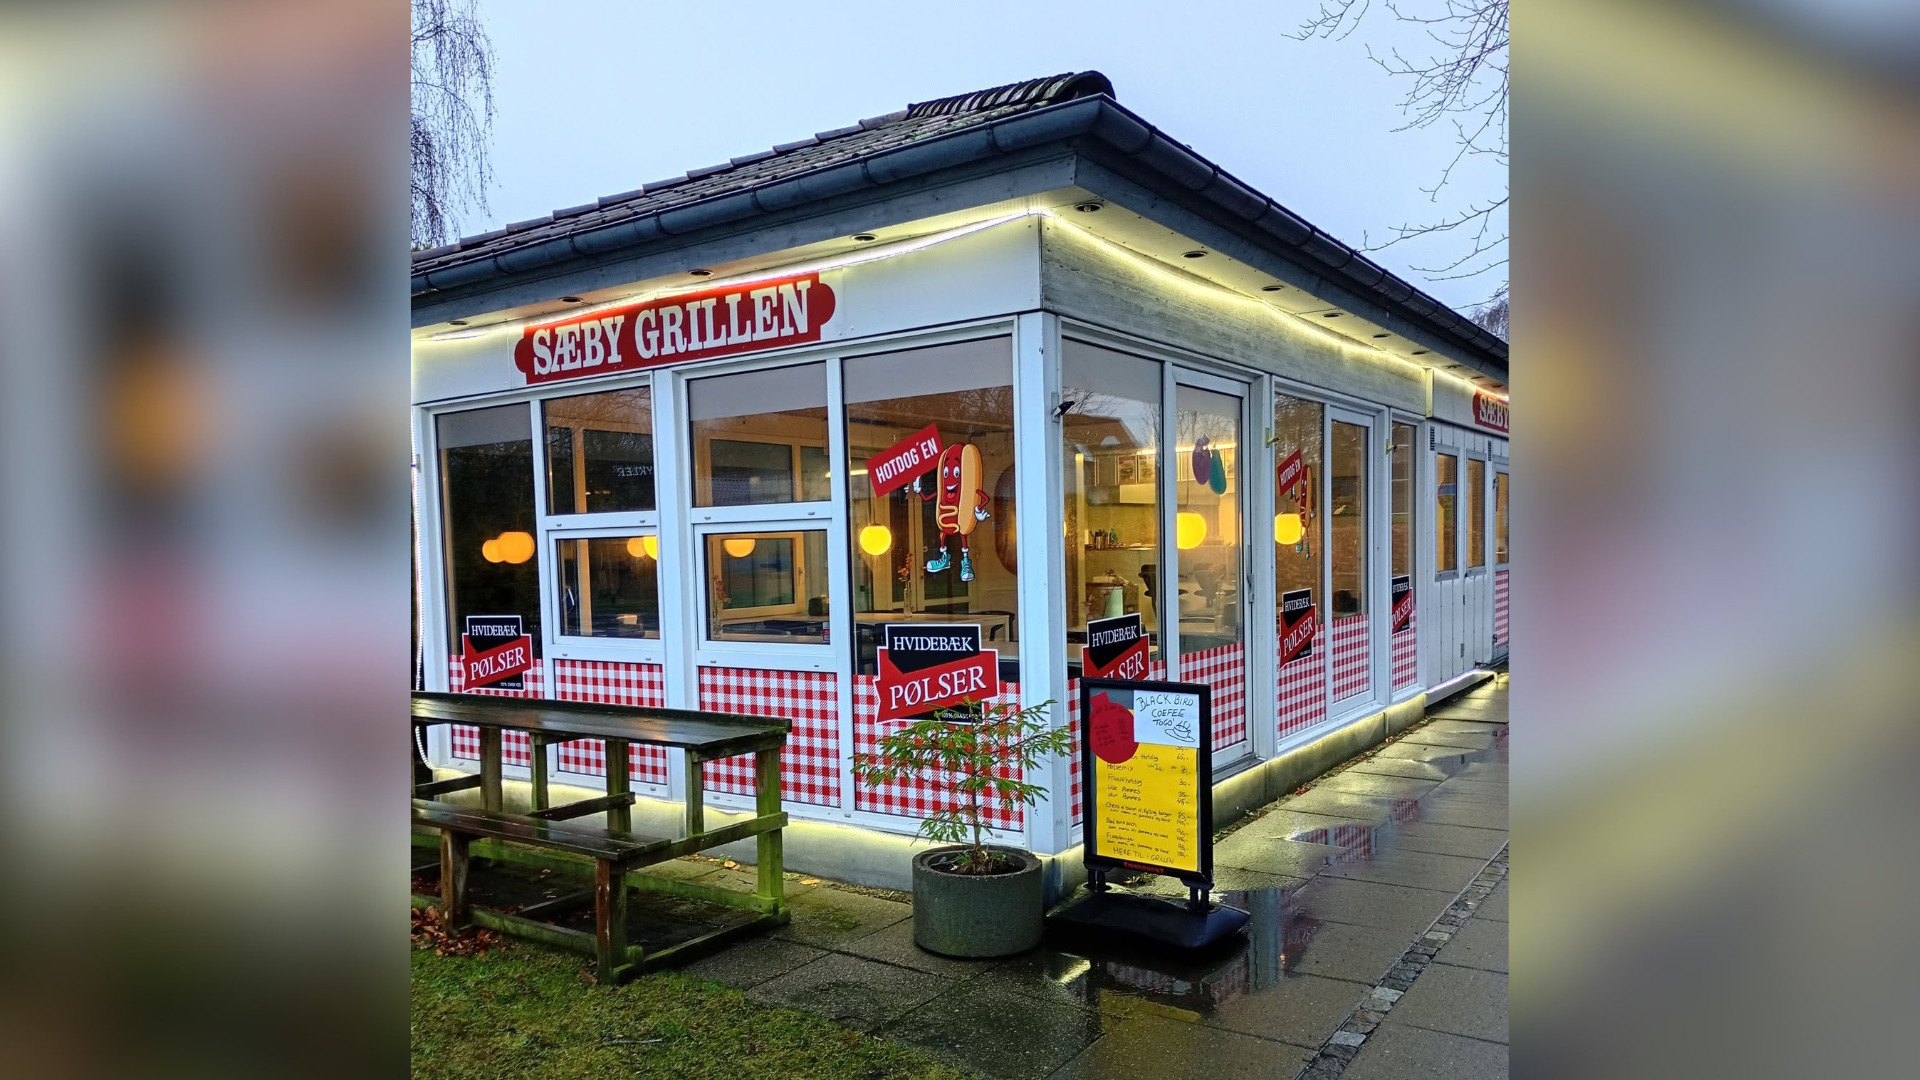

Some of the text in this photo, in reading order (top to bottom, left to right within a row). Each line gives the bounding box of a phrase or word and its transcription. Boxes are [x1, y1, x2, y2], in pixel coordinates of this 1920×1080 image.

[533, 279, 812, 375] SÆBY GRILLEN
[1480, 395, 1509, 429] SÆBY
[471, 625, 518, 636] HVIDEBÆK
[893, 637, 974, 651] HVIDEBÆK
[1092, 625, 1138, 648] HVIDEBÆK
[1283, 616, 1314, 658] PØLSER
[470, 647, 526, 681] PØLSER
[889, 666, 987, 710] PØLSER
[1136, 694, 1194, 712] BLACK BIRD
[1113, 846, 1132, 857] MERE
